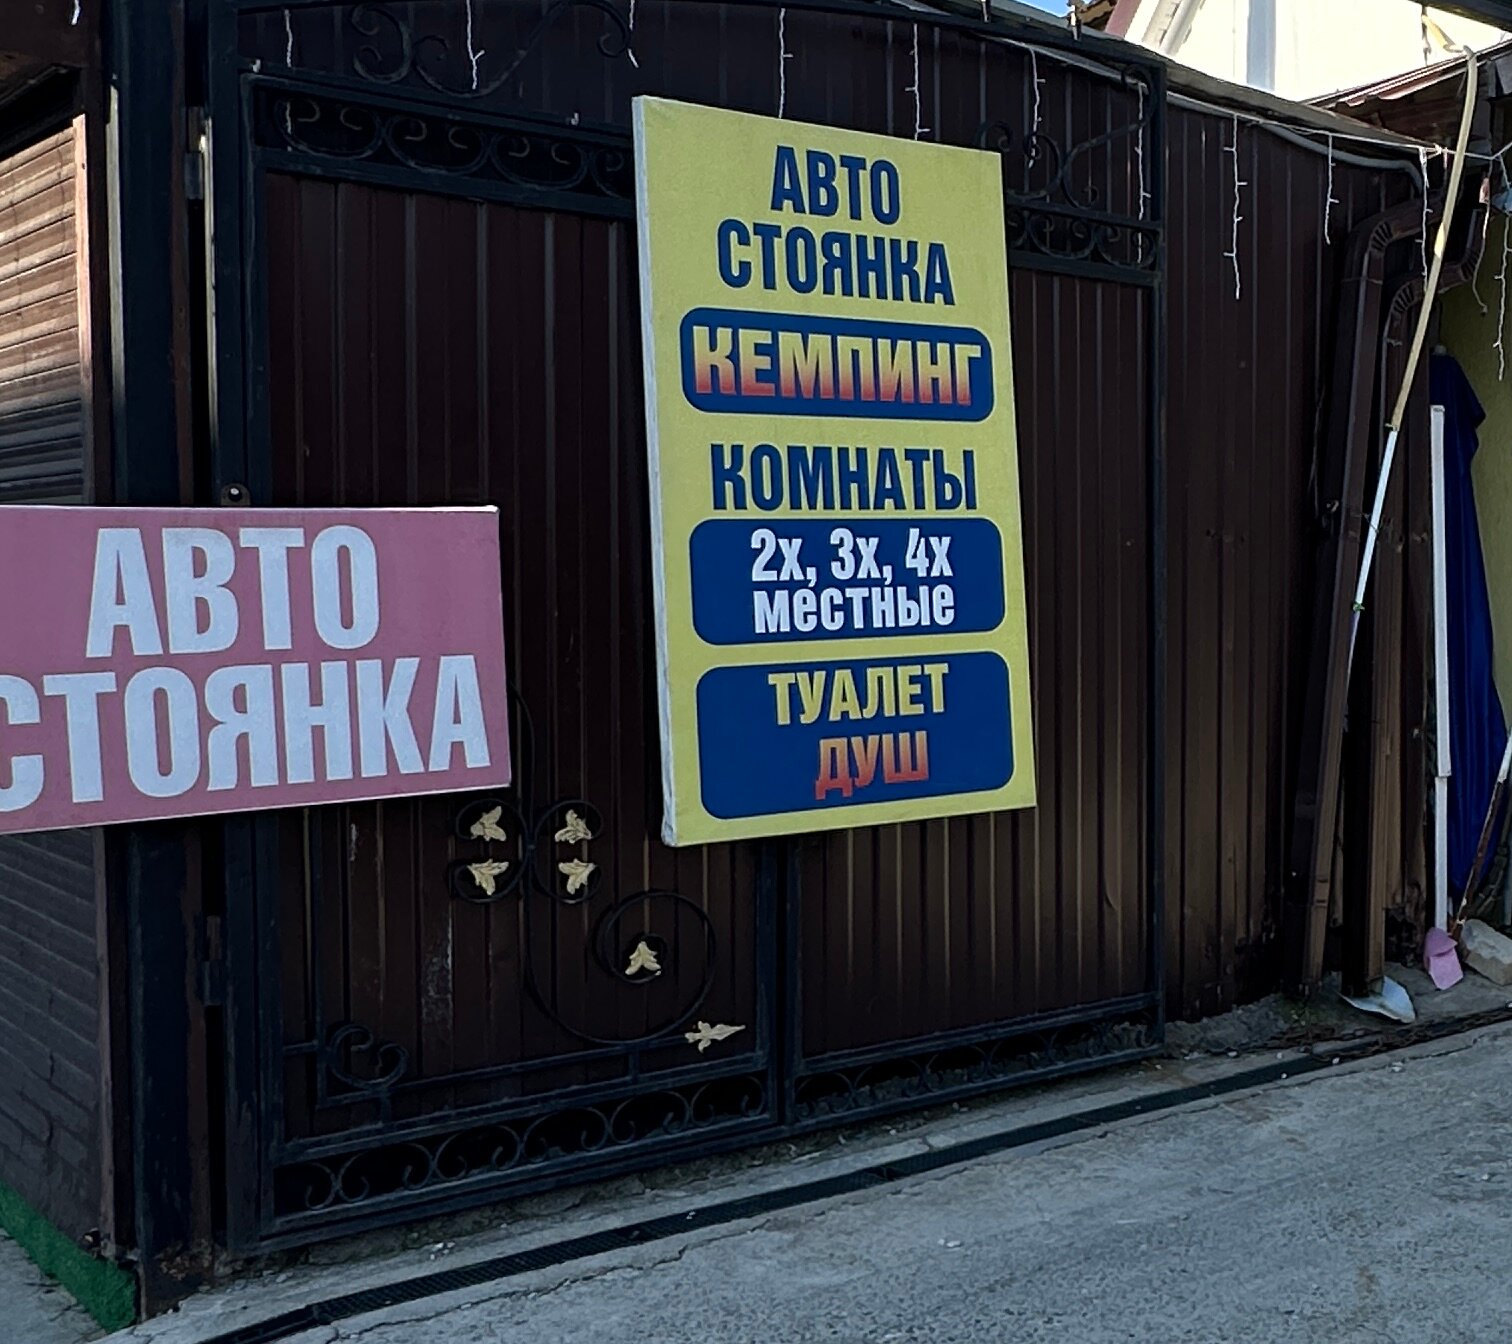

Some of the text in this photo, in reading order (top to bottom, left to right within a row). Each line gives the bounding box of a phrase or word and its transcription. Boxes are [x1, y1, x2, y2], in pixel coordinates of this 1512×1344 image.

[770, 145, 901, 225] АВТО
[717, 219, 955, 305] СТОЯНКА
[692, 325, 982, 407] КЕМПИНГ
[710, 443, 978, 511] КОМНАТЫ
[86, 524, 381, 658] АВТО
[750, 527, 954, 587] 2х, 3х, 4х
[752, 584, 955, 634] местные
[768, 663, 949, 726] ТУАЛЕТ
[0, 655, 491, 813] СТОЯНКА
[815, 730, 929, 800] ДУШ
